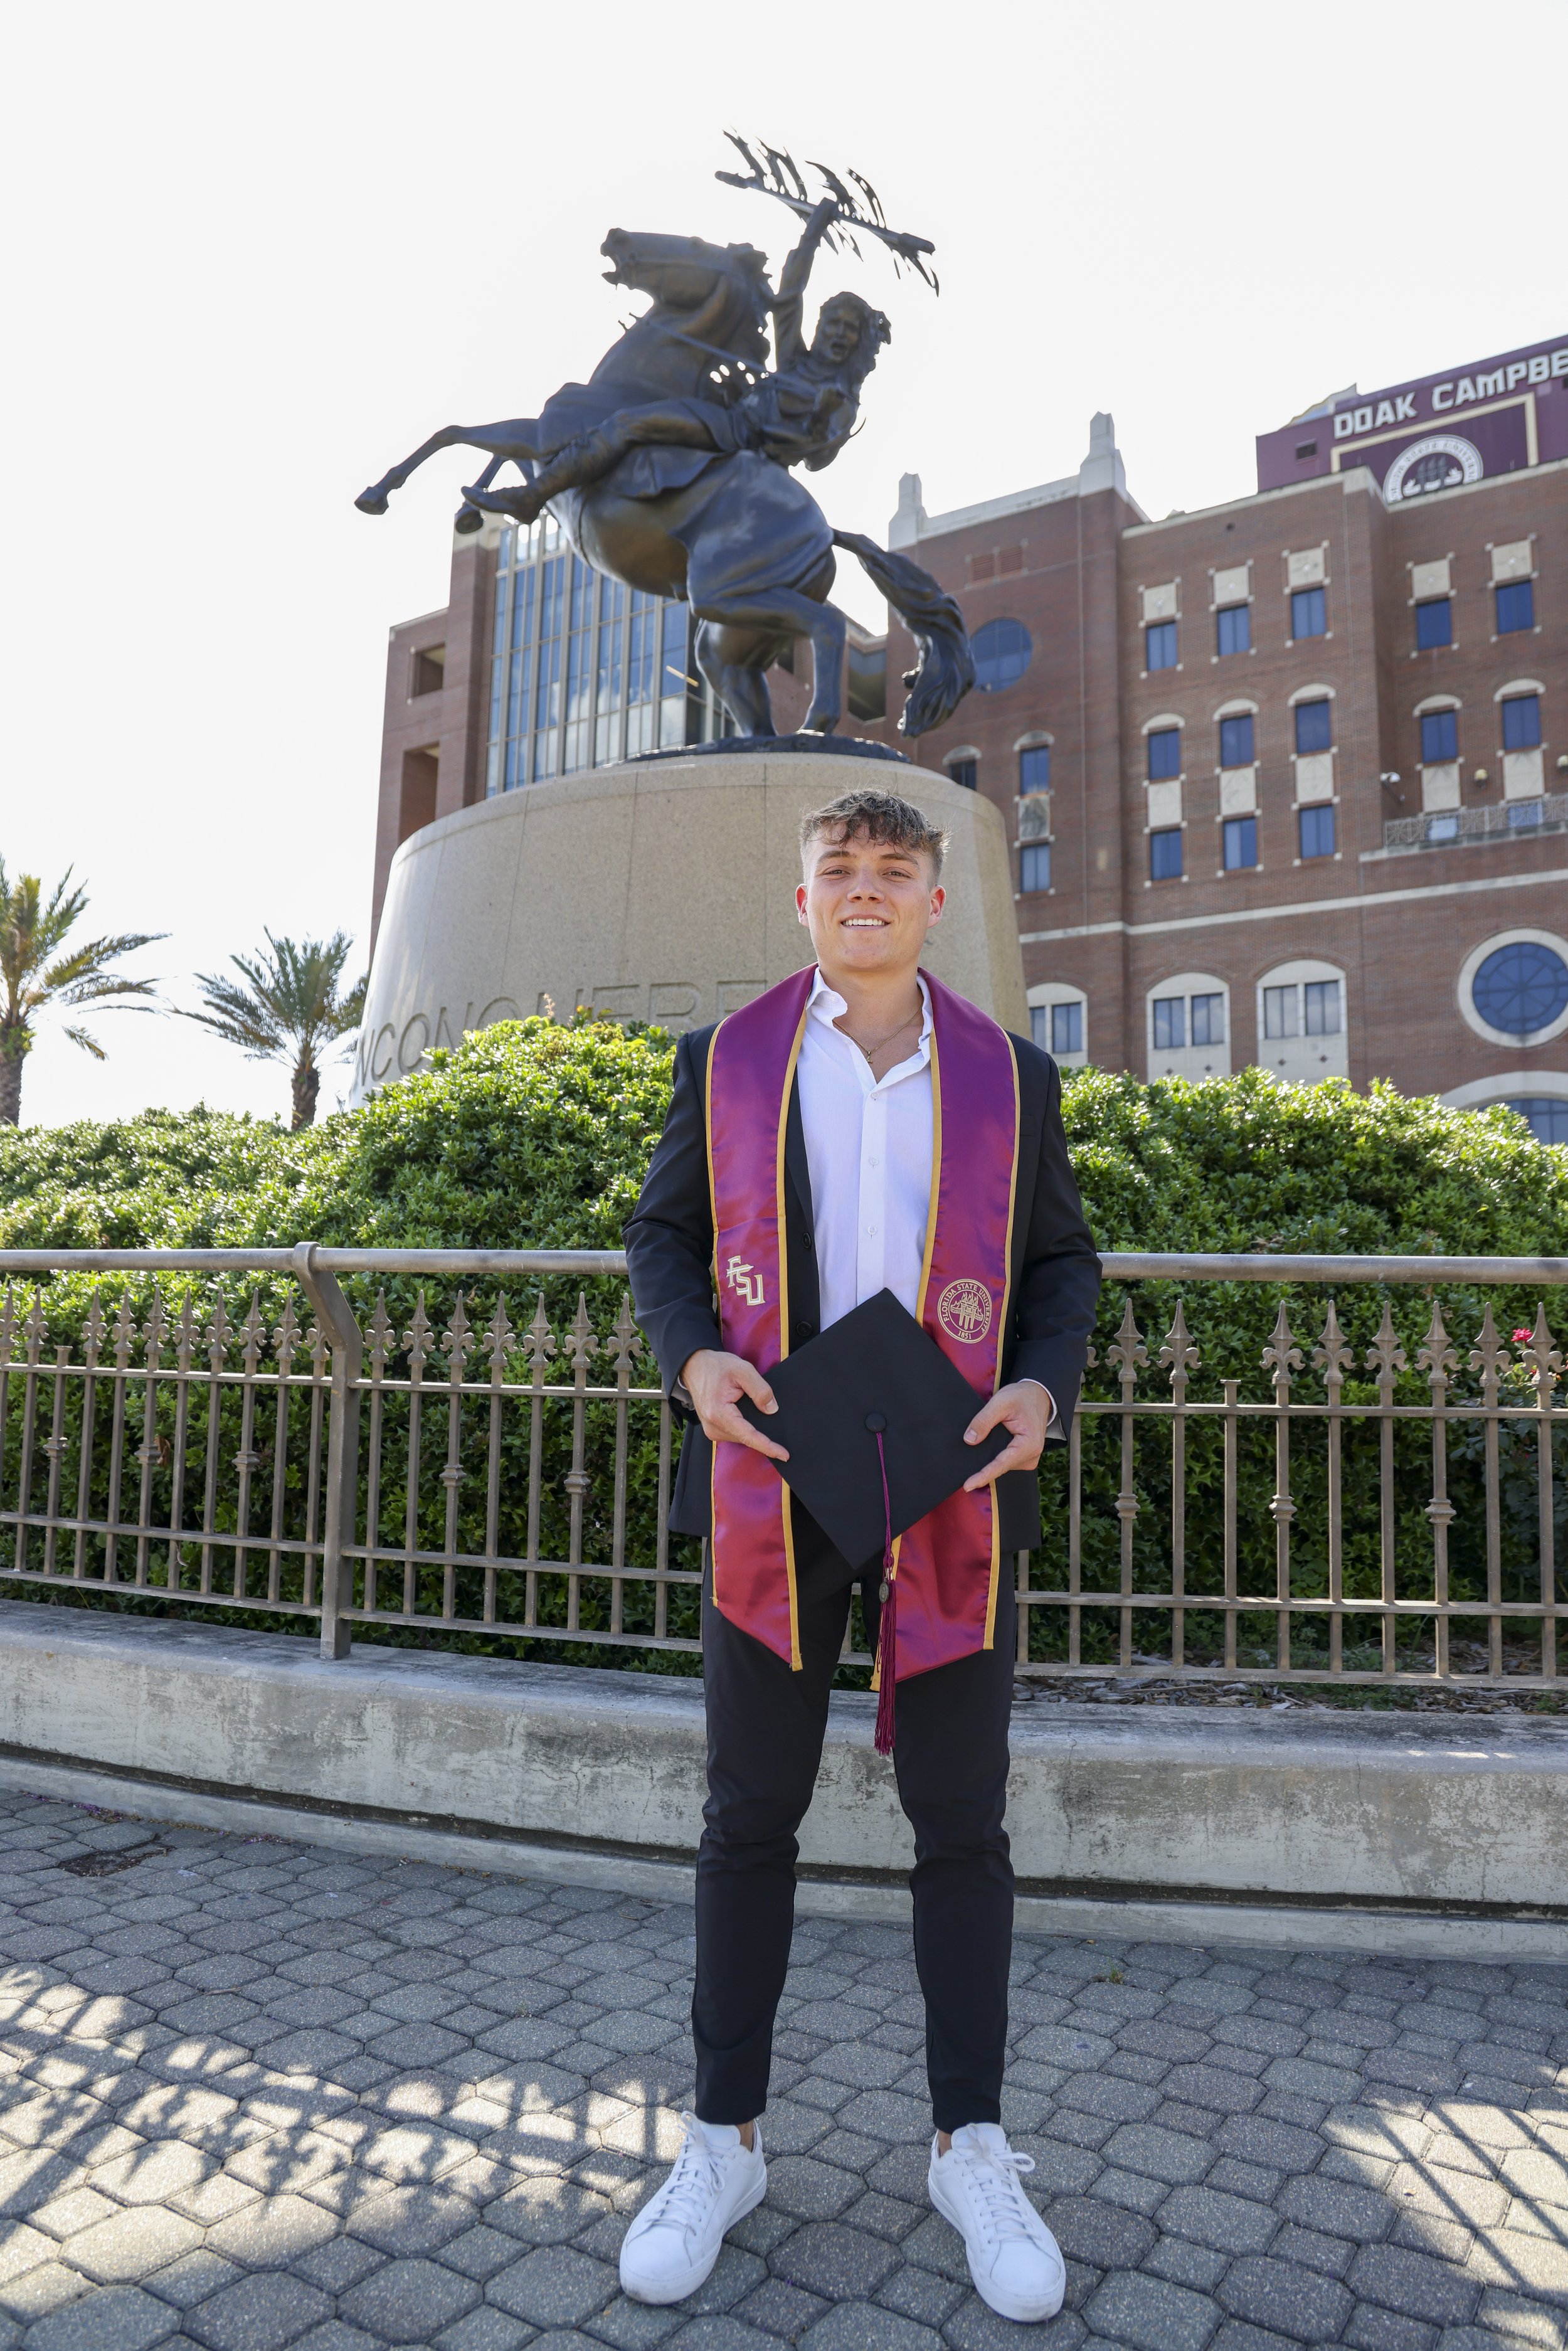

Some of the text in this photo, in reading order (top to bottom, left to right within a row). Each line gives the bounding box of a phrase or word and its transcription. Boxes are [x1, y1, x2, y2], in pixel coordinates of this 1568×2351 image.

[1334, 348, 1568, 439] DOAK CAMPBE
[726, 1255, 765, 1305] FSU
[941, 1288, 956, 1322] FLORIDA
[978, 1288, 990, 1334] UNIVERSITY
[958, 1330, 972, 1339] 1851
